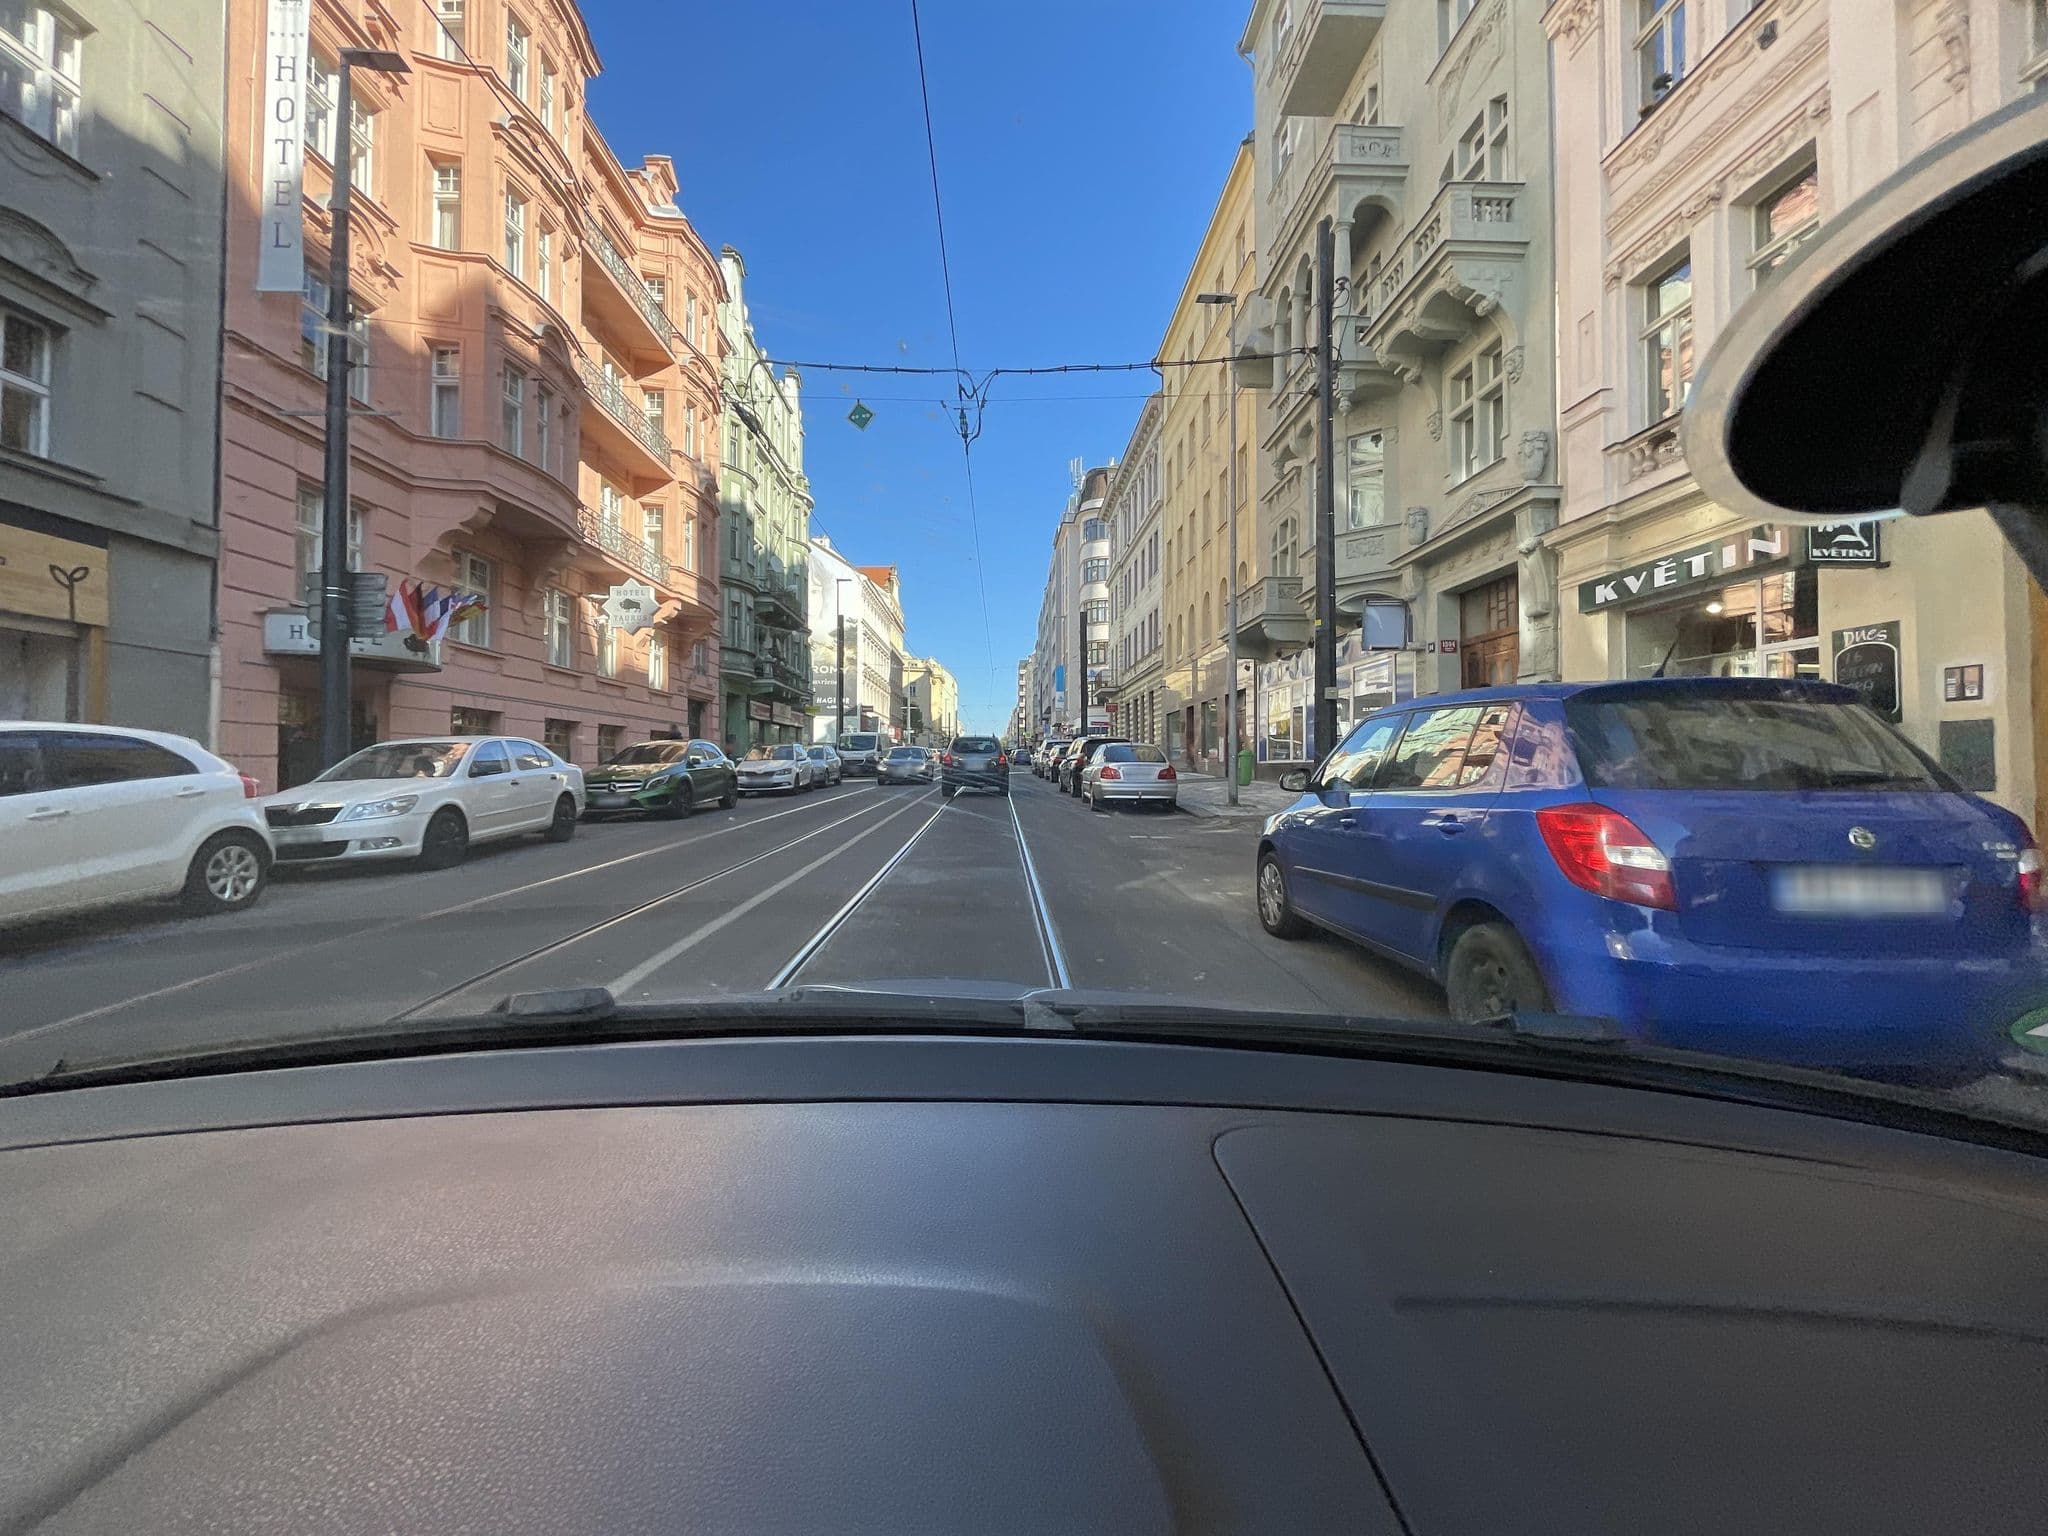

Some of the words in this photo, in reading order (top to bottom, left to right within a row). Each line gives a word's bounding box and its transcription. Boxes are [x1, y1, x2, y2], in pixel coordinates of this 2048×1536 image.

[272, 55, 297, 249] HOTEL
[1595, 530, 1782, 604] KVĚTIN
[1812, 547, 1873, 557] KVĚTINY
